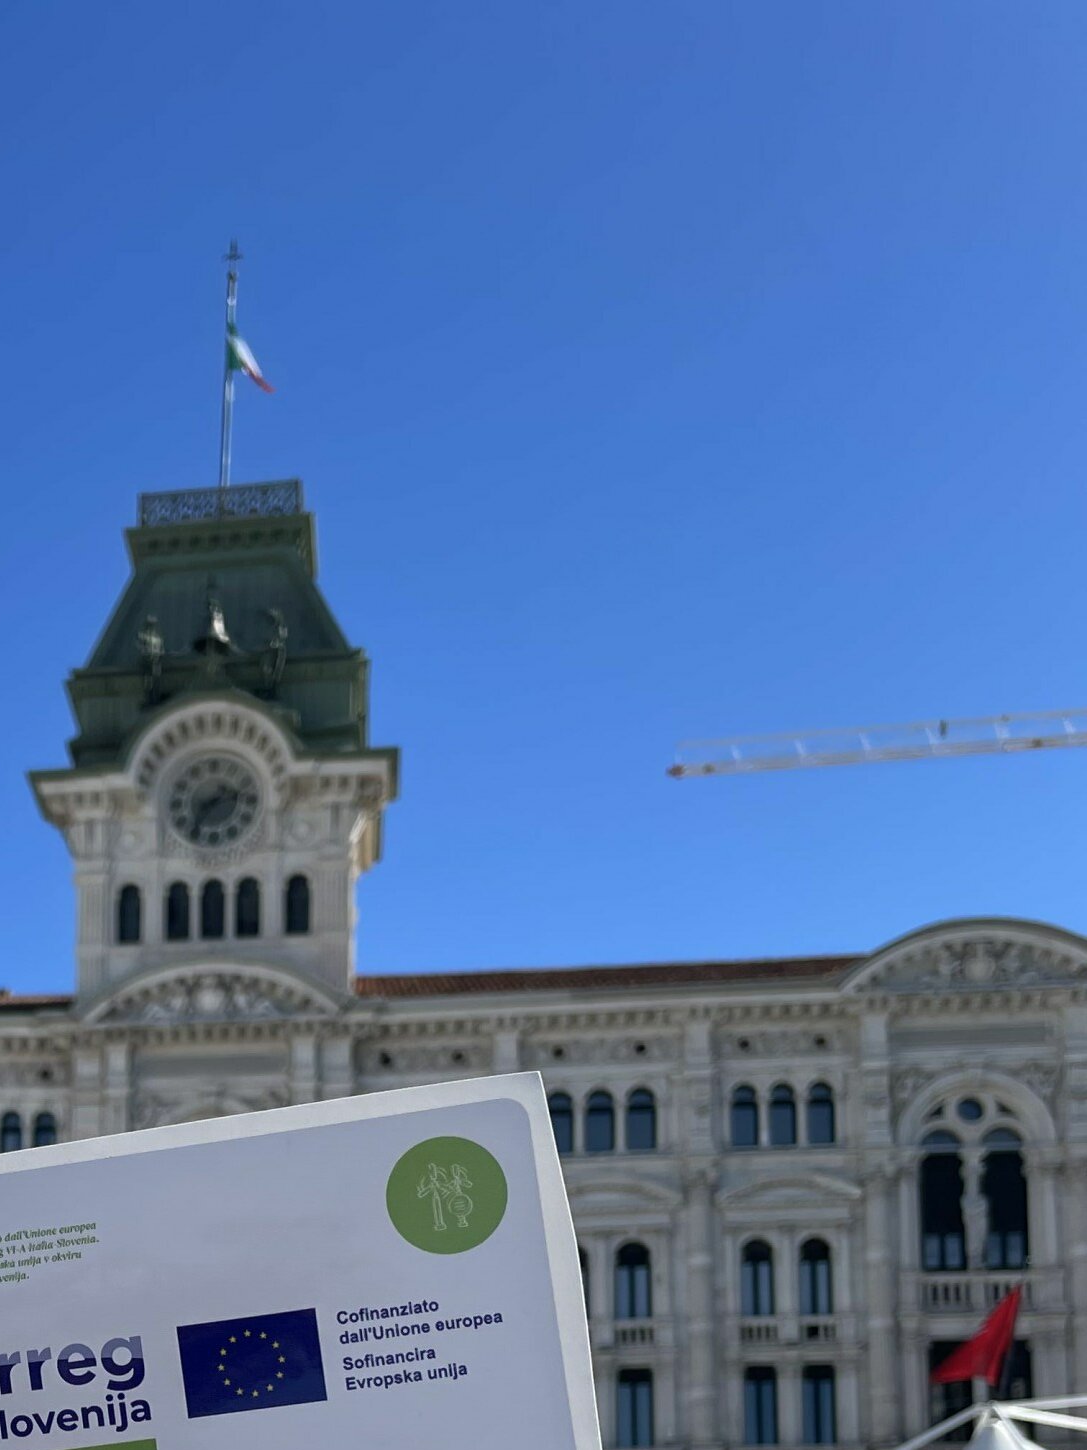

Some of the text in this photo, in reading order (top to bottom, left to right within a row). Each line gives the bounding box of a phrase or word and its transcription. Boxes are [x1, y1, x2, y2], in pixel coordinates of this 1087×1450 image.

[59, 1222, 96, 1234] europea
[17, 1256, 41, 1268] unija
[44, 1256, 50, 1264] v
[52, 1251, 82, 1263] okviru
[336, 1299, 439, 1325] Cofinanziato
[339, 1312, 503, 1345] dall'Unione europea
[343, 1347, 436, 1371] Sofinancira
[345, 1363, 468, 1391] Evropska unija
